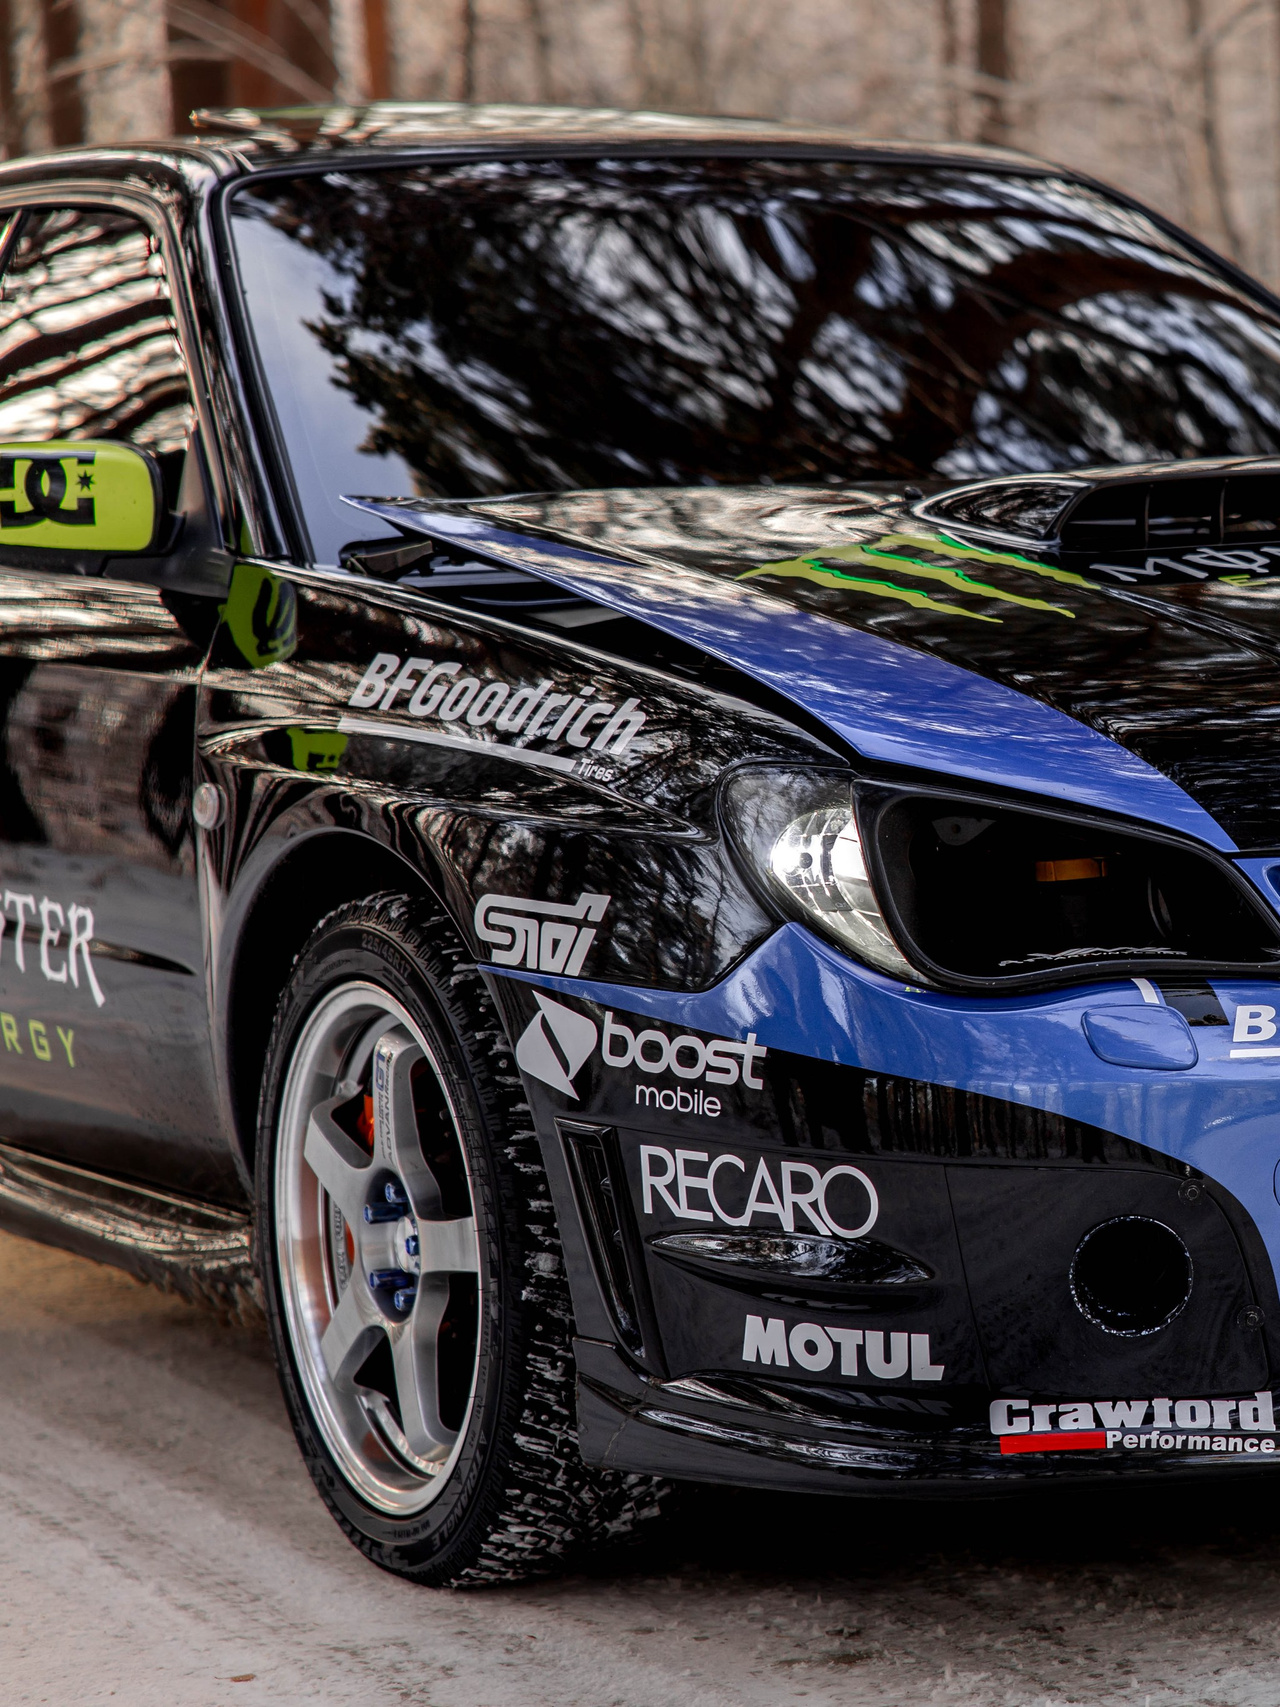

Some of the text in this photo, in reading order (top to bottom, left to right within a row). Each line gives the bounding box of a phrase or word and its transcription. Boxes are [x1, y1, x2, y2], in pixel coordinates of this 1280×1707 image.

[348, 652, 647, 756] BFGoodrich
[577, 757, 614, 783] Tires
[0, 888, 106, 1008] TER
[602, 1010, 768, 1090] boost
[635, 1083, 723, 1118] mobile
[639, 1144, 880, 1240] RECARO
[742, 1313, 946, 1382] MOTUL
[989, 1390, 1277, 1435] Crawford
[1106, 1429, 1276, 1453] Performance
